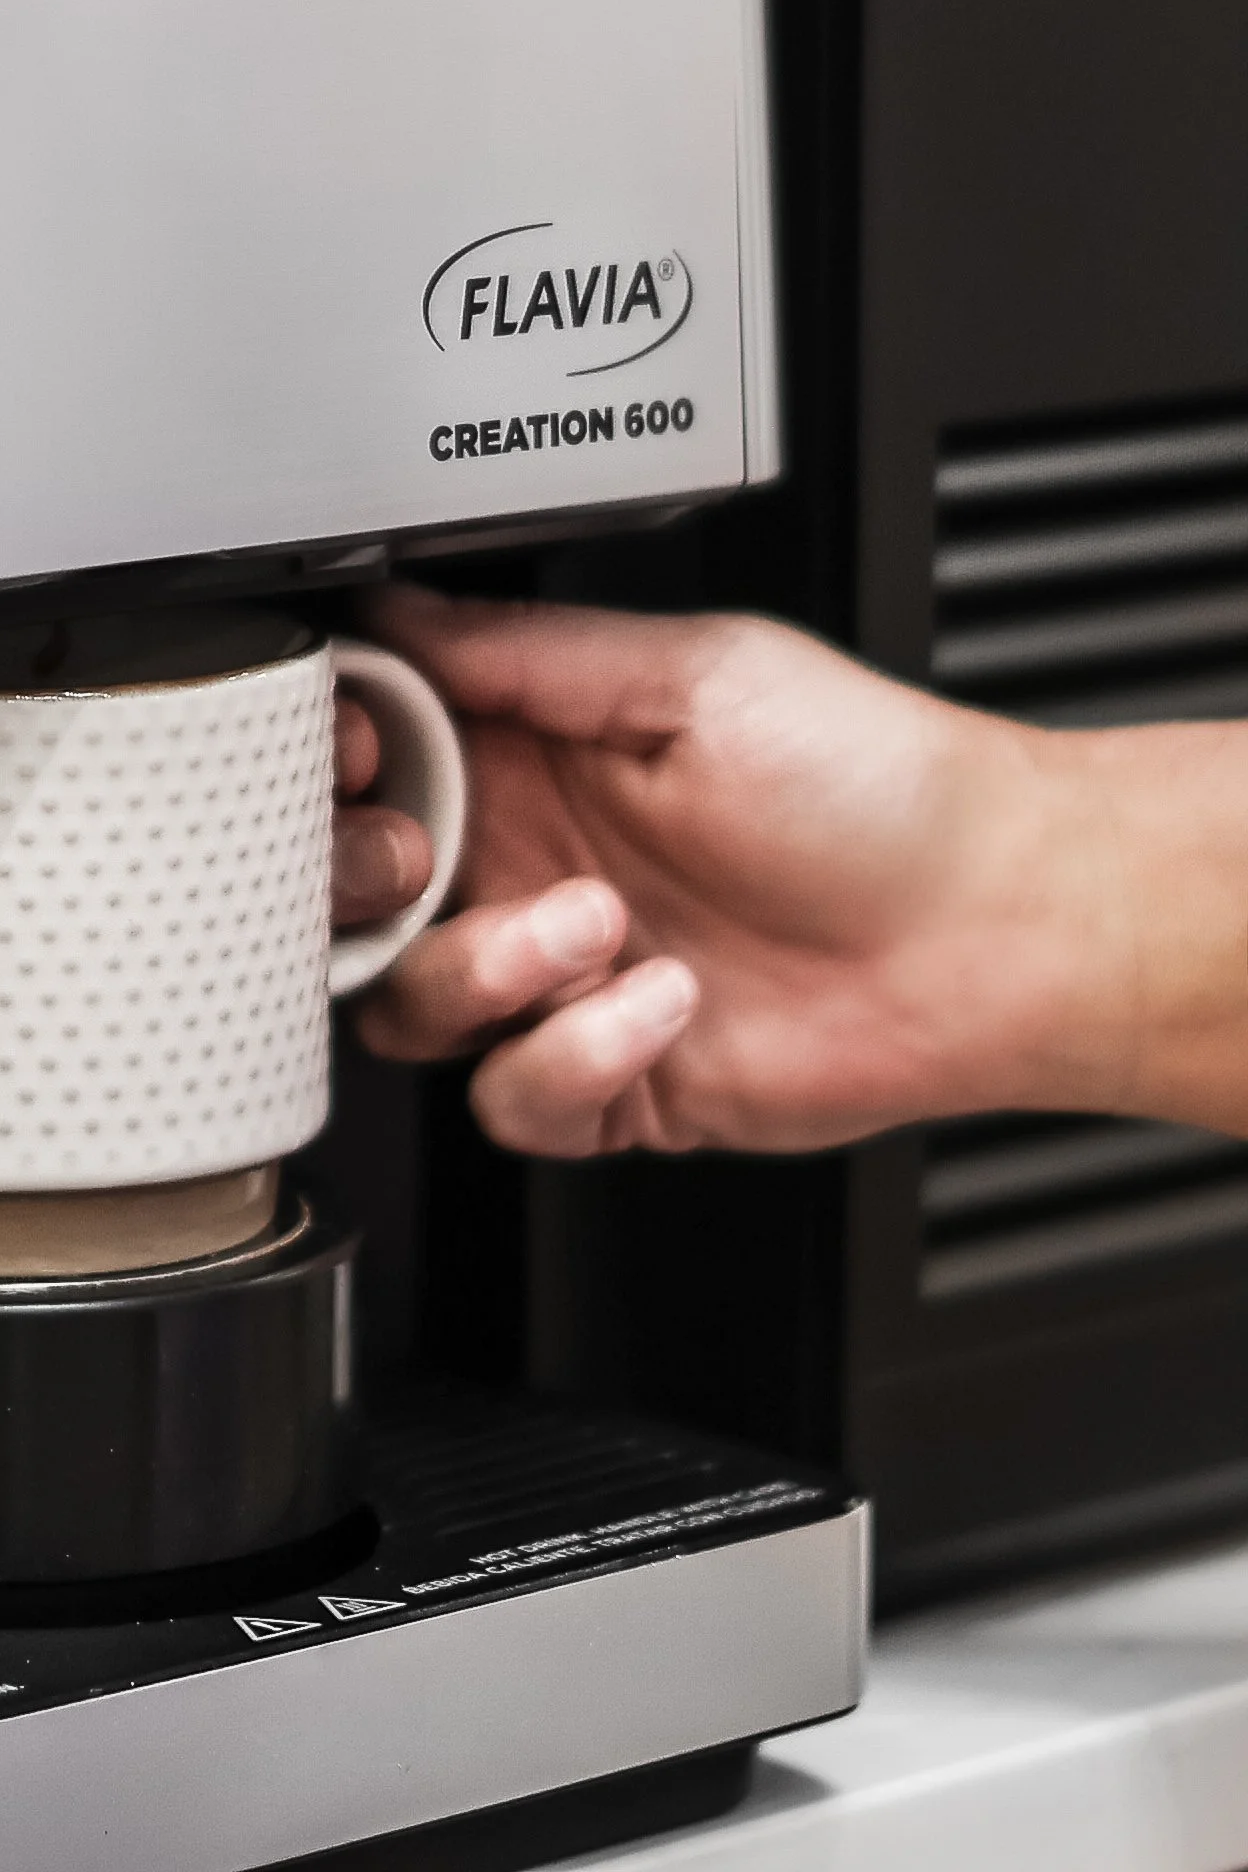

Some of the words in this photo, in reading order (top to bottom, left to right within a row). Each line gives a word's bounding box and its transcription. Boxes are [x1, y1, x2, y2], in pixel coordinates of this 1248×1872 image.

[460, 261, 662, 340] FLAVIA
[429, 406, 615, 462] CREATION
[624, 397, 695, 439] 600
